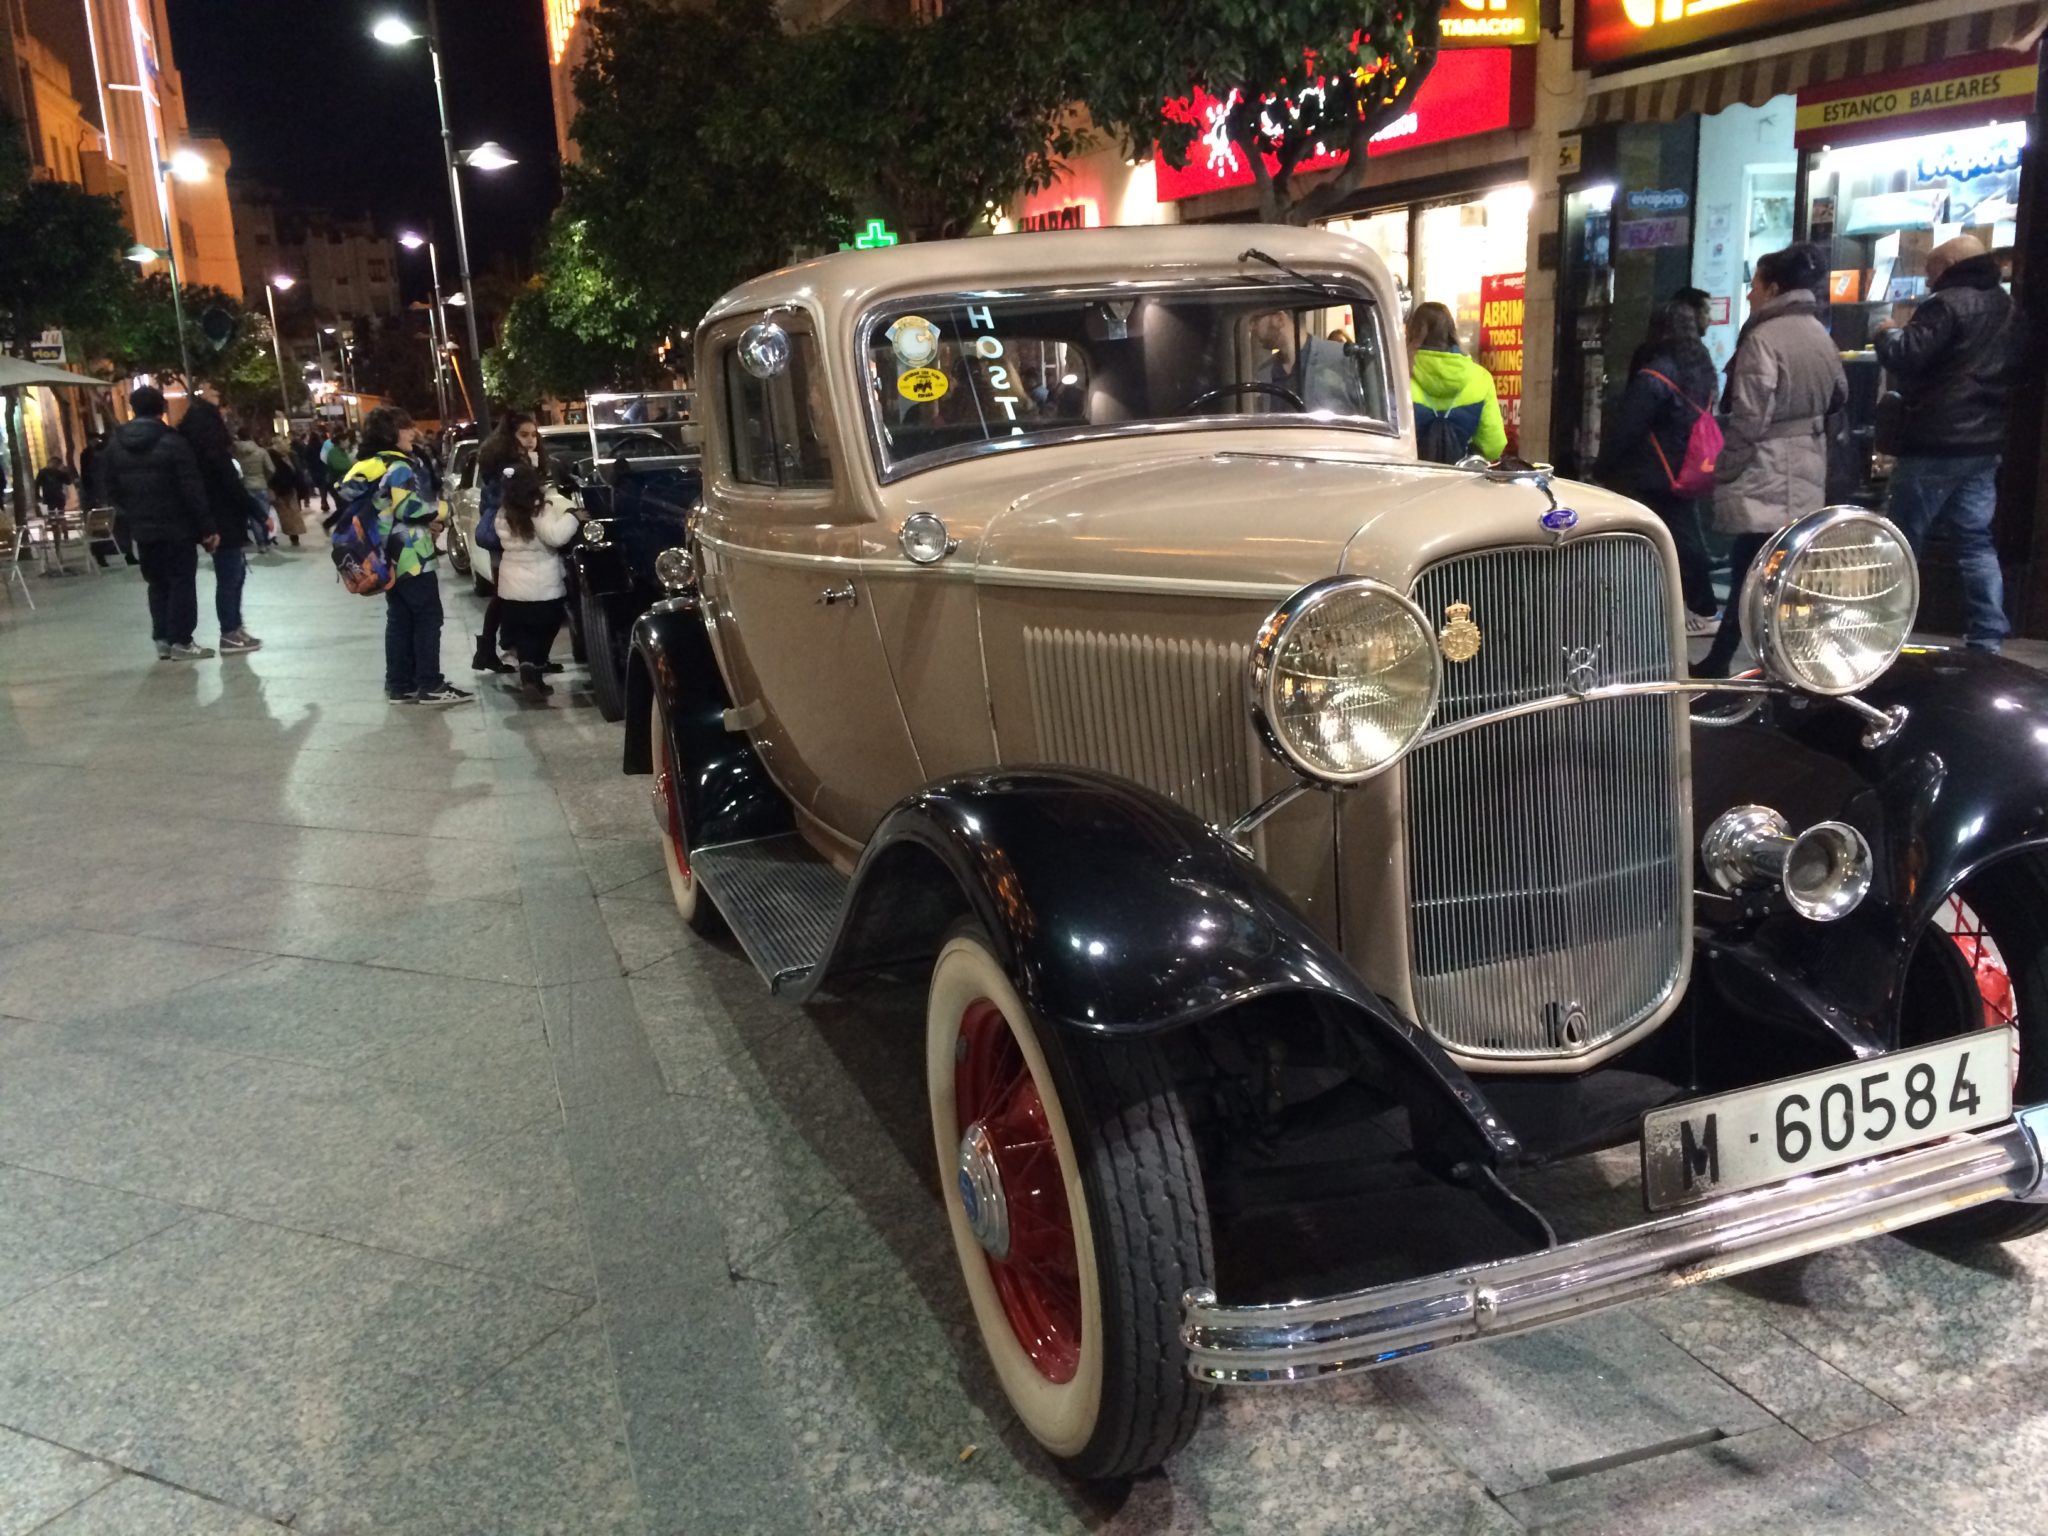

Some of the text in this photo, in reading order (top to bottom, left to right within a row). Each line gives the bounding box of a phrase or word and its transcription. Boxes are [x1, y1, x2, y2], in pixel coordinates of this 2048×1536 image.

[1439, 17, 1525, 36] TABACOS
[1823, 74, 2001, 122] ESTANCO BALEARES
[1483, 300, 1525, 327] ABRIM
[1489, 329, 1515, 346] TODOS
